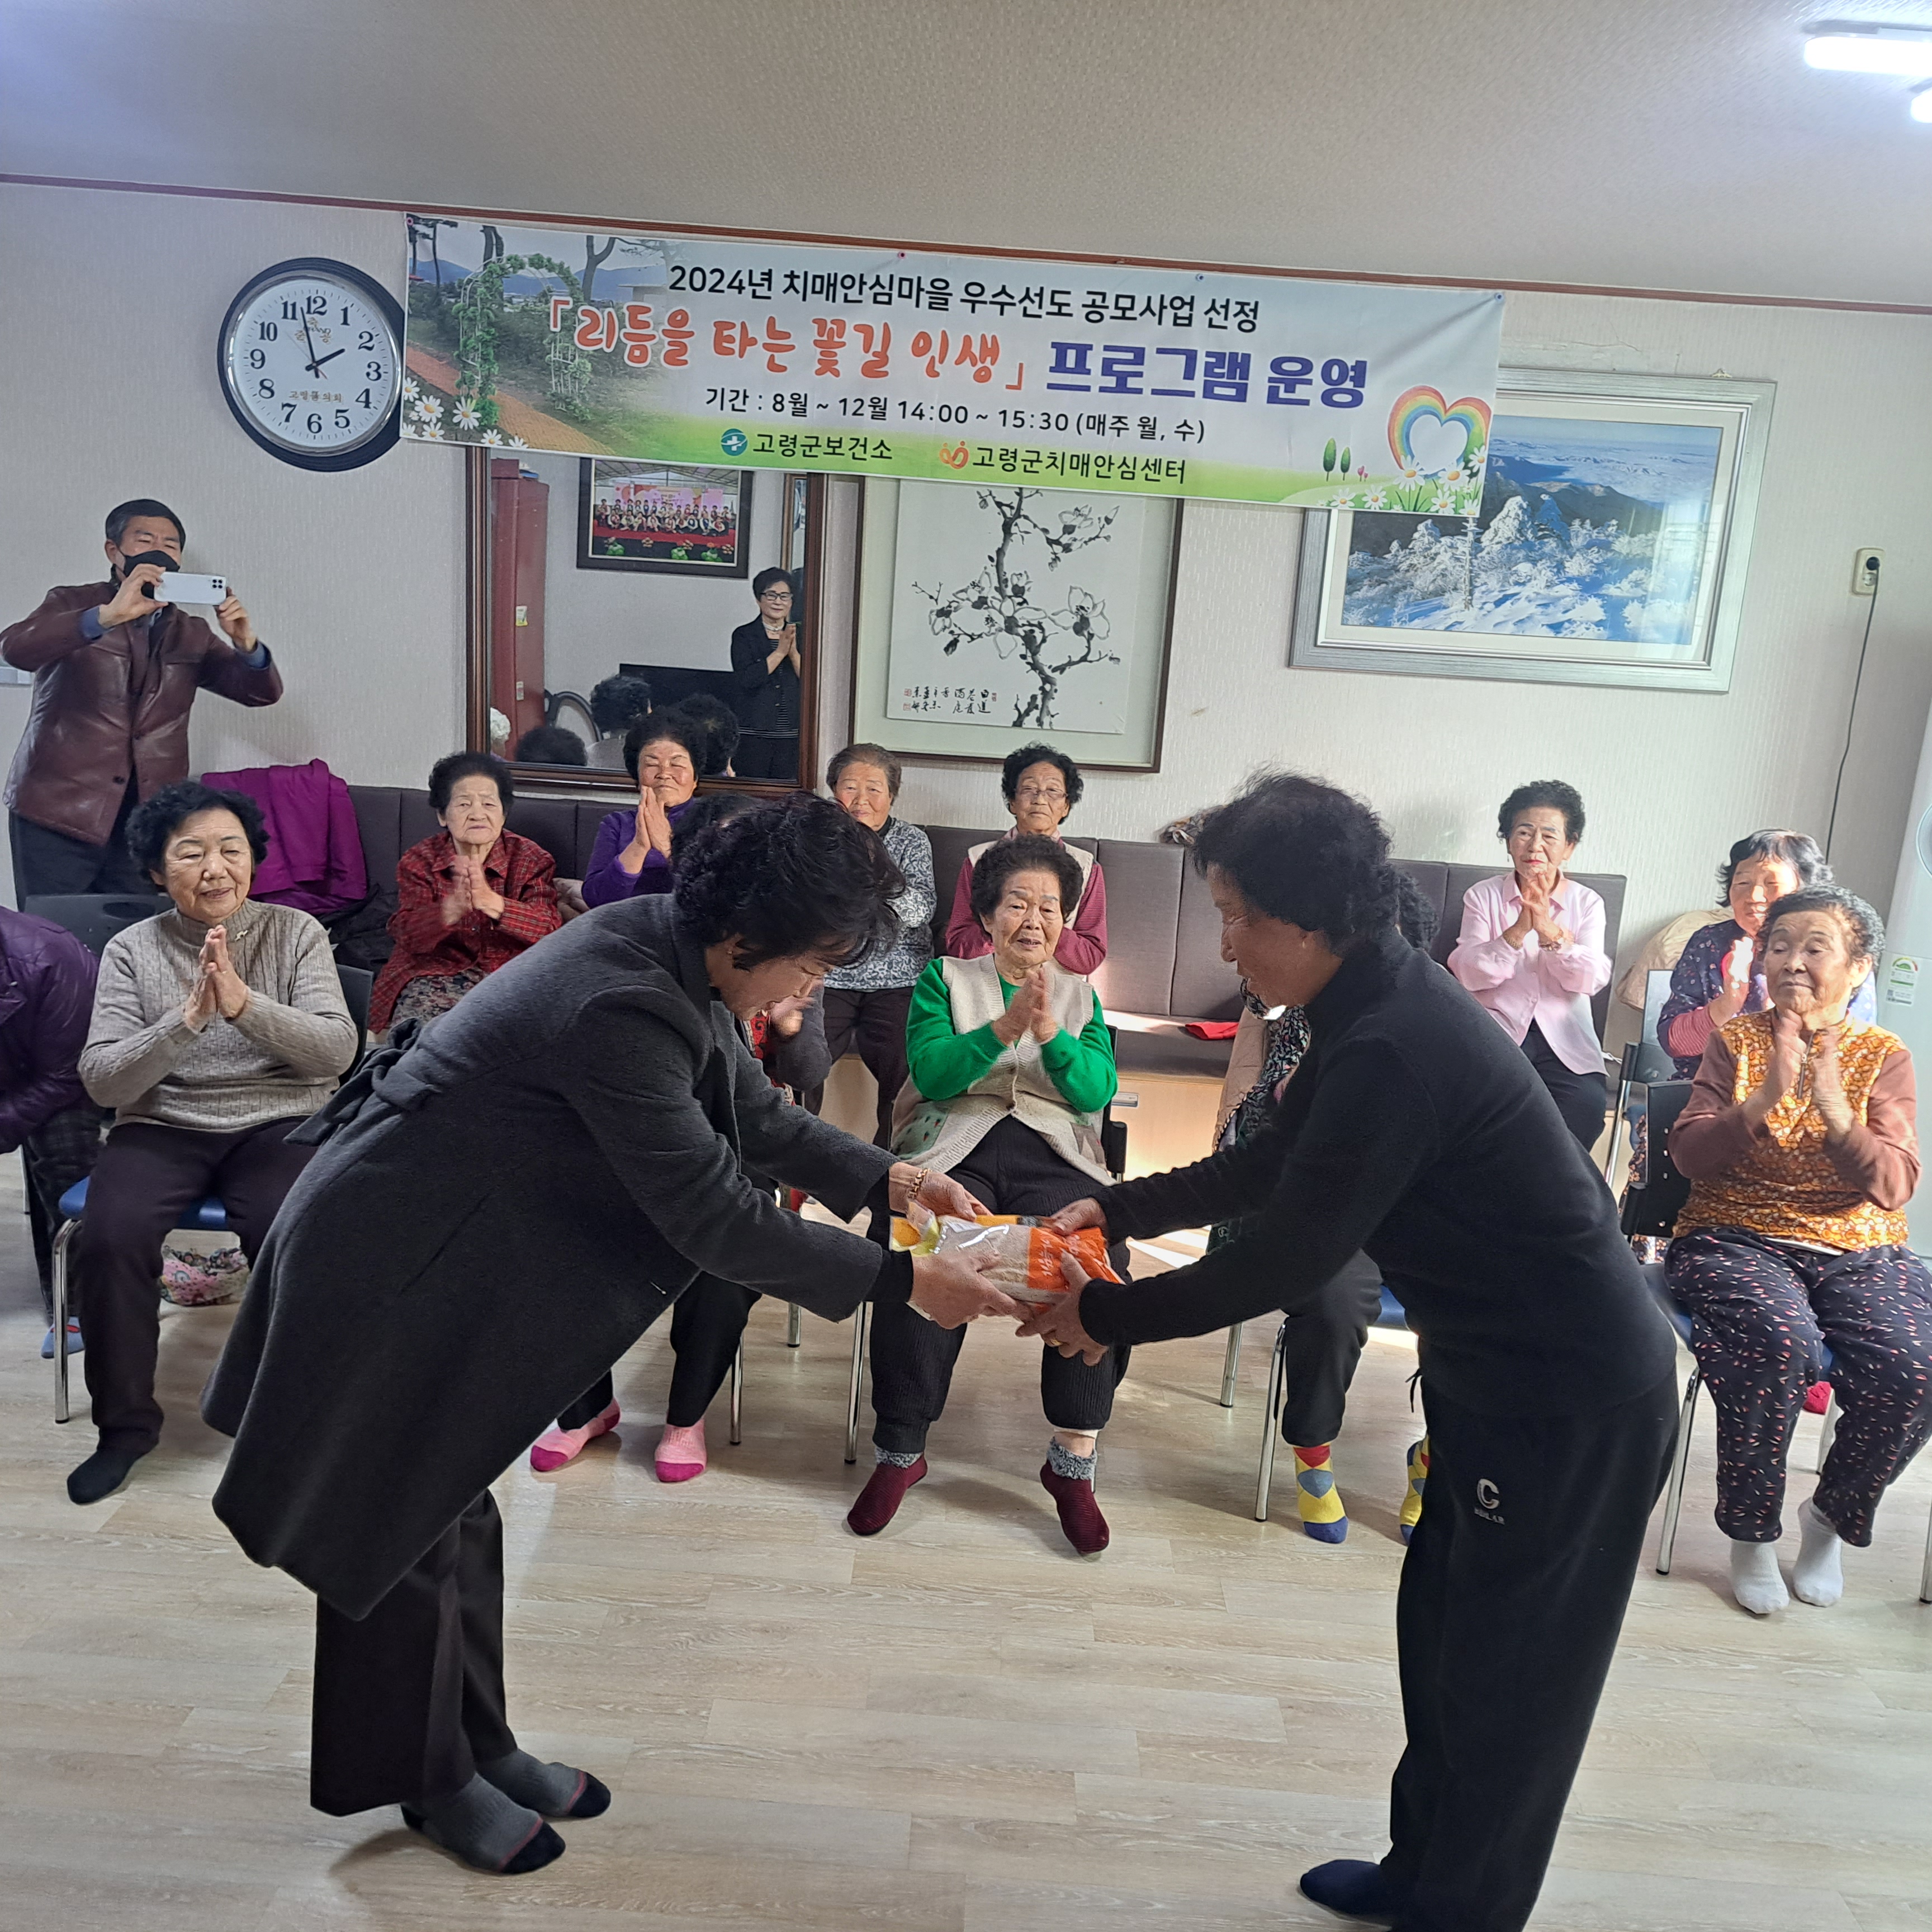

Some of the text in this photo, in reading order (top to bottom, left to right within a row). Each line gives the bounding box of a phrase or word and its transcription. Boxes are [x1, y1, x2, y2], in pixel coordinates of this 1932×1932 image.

[306, 295, 327, 315] 12
[669, 266, 1259, 333] 2024년 치매안심마을 우수선도 공모사업 선정
[282, 301, 298, 320] 11
[341, 307, 350, 326] 1
[259, 321, 277, 341] 10
[358, 332, 375, 351] 2
[250, 349, 266, 369] 9
[713, 316, 795, 372] 타는
[812, 318, 891, 378] 꽃길
[1046, 342, 1251, 402] 프로그램
[1267, 356, 1367, 408] 운영
[366, 362, 382, 381] 3
[258, 378, 274, 399] 8
[356, 389, 372, 409] 4
[281, 402, 297, 423] 7
[335, 409, 350, 428] 5
[706, 388, 749, 412] 기간
[772, 393, 808, 417] 8월
[839, 397, 887, 420] 12월
[898, 401, 968, 423] 14:00
[999, 409, 1068, 431] 15:30
[1137, 416, 1165, 441] 월,
[1175, 420, 1205, 443] 수)
[307, 413, 322, 433] 6
[753, 434, 893, 461] 고령군보건소
[973, 447, 1186, 484] 고령군치매안심센터
